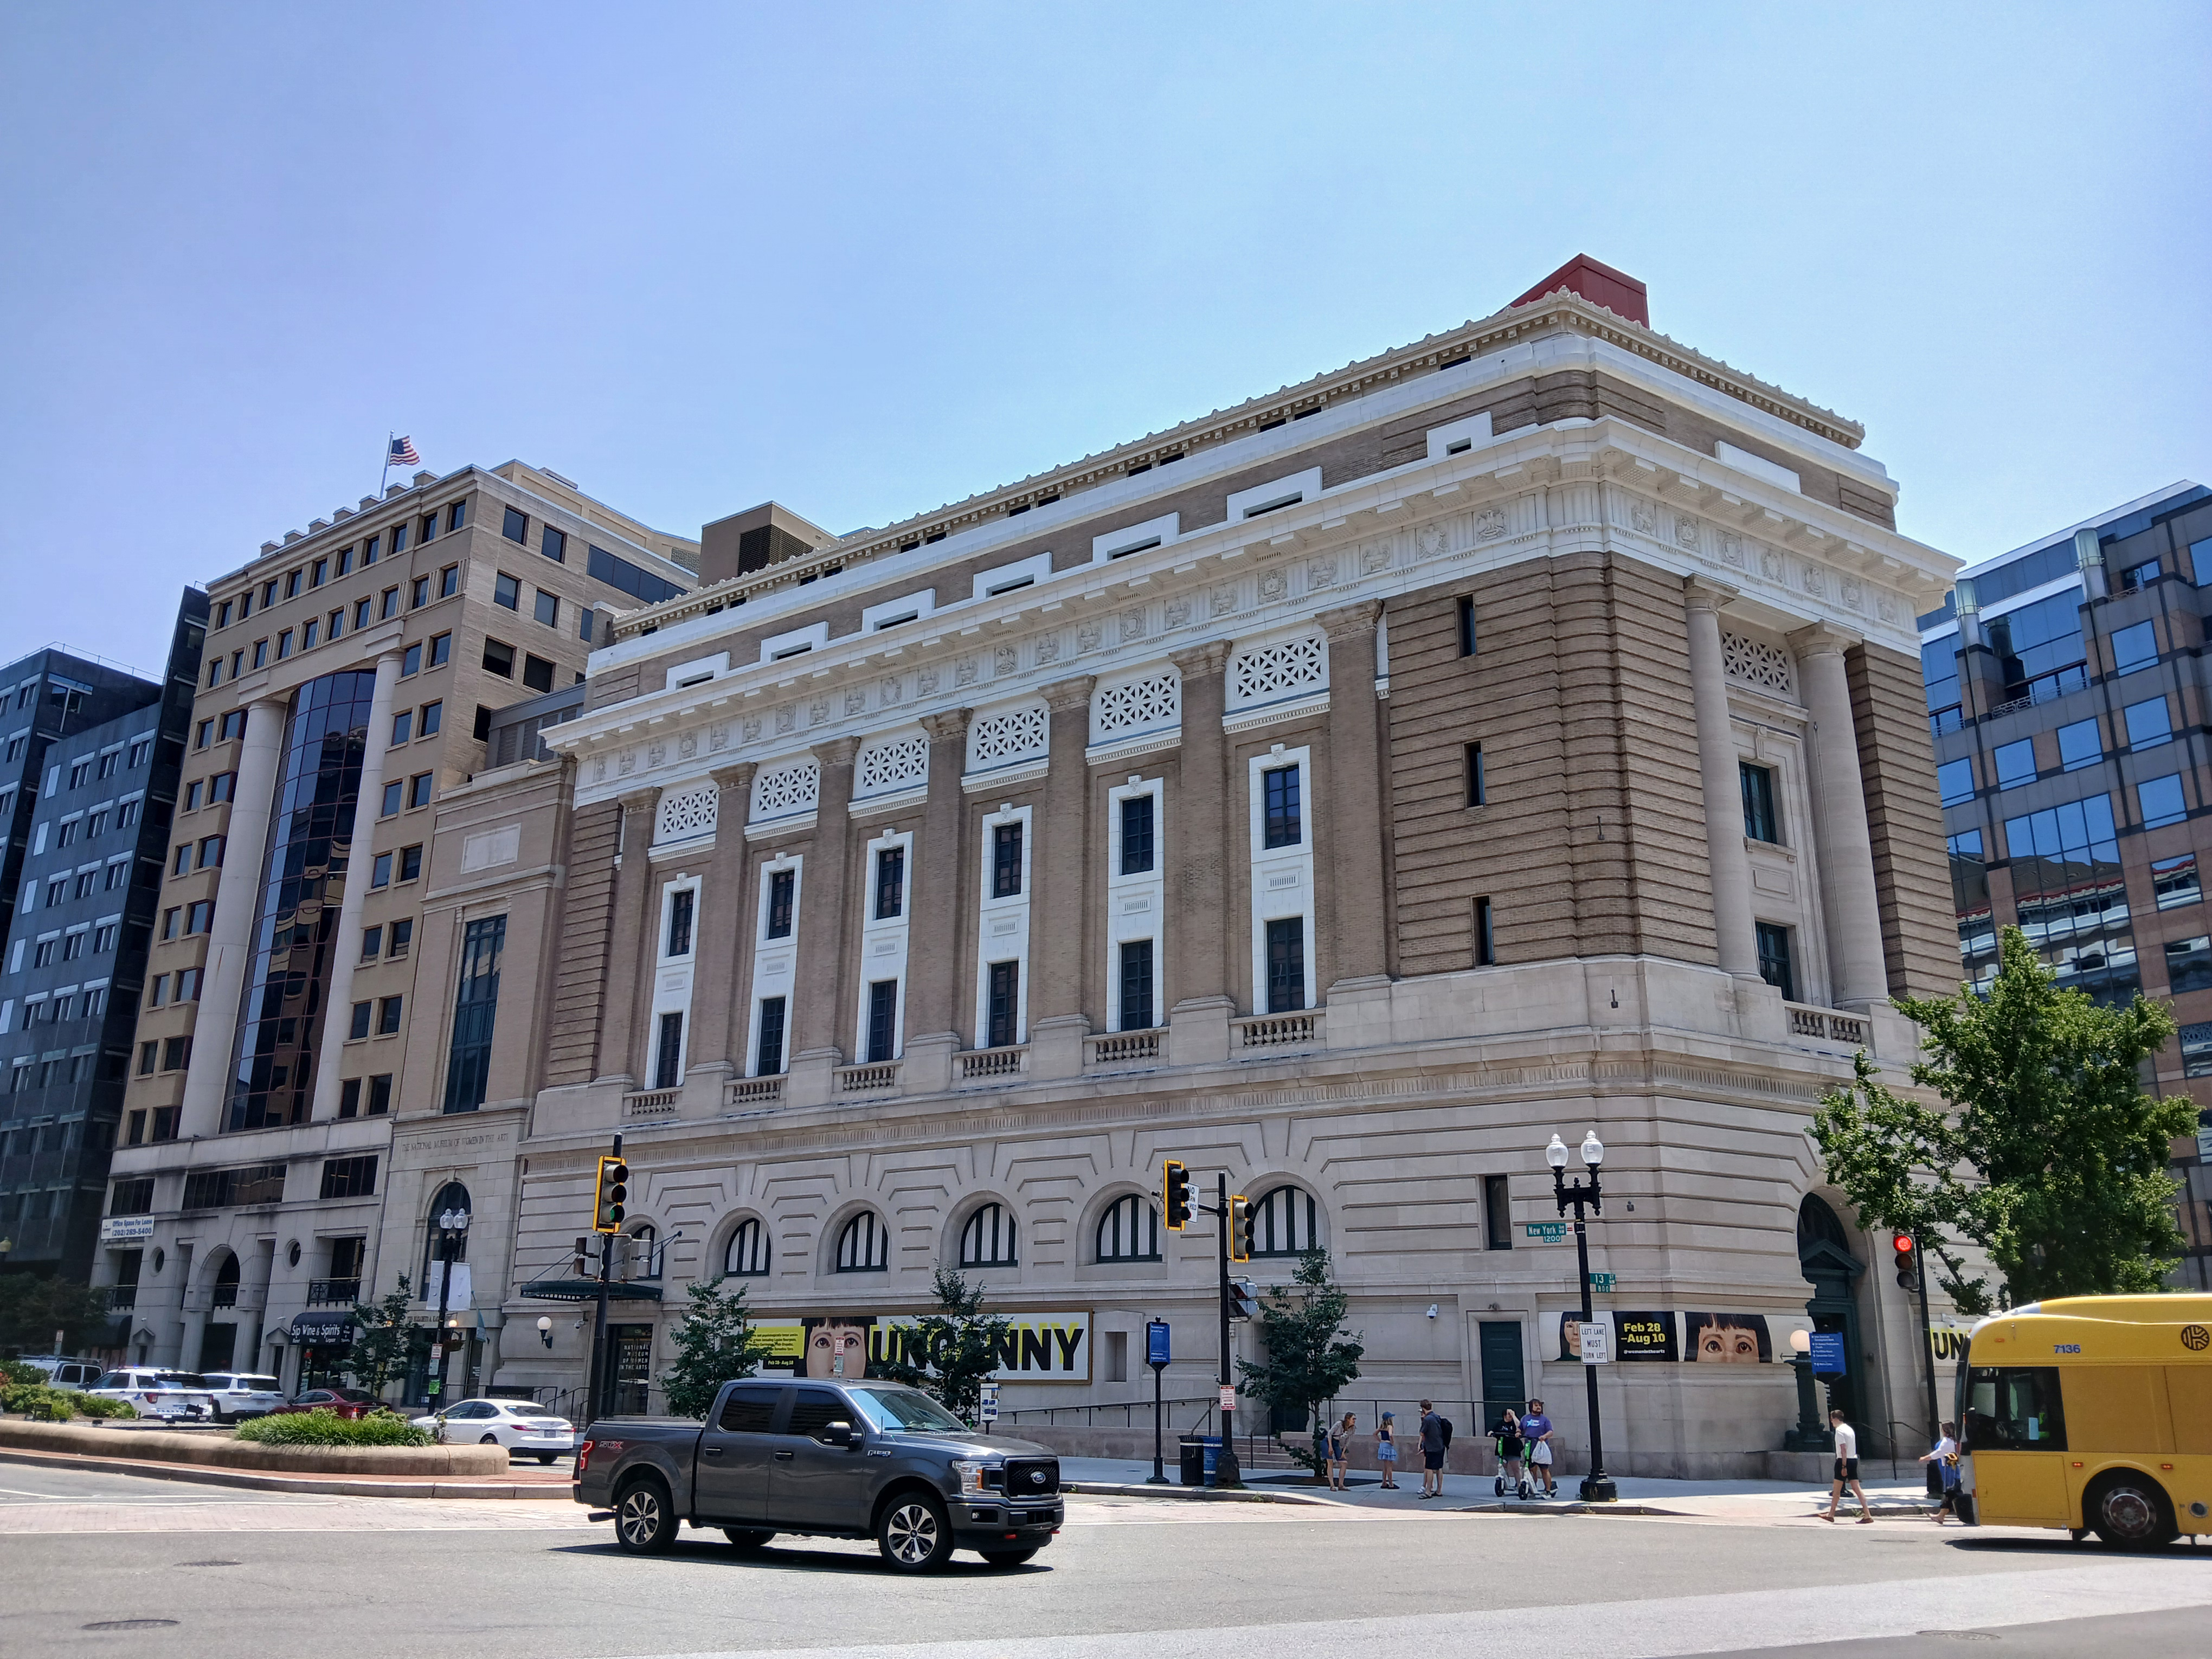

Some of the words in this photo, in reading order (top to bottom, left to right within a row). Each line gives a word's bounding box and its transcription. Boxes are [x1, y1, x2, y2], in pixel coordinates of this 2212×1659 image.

[1187, 1185, 1195, 1194] NO
[124, 1219, 134, 1228] Space
[1528, 1226, 1541, 1236] New
[1542, 1225, 1557, 1234] York
[1595, 1274, 1604, 1284] 13
[1598, 1285, 1609, 1293] 800
[292, 1324, 301, 1339] Sip
[303, 1324, 316, 1336] Wine
[321, 1323, 340, 1339] Spirits
[1623, 1323, 1645, 1333] Feb
[1647, 1323, 1661, 1333] 28
[1652, 1333, 1666, 1342] 10
[870, 1324, 1084, 1372] UNCNNY
[1587, 1340, 1601, 1348] MUST
[2053, 1345, 2081, 1353] 7136
[599, 1441, 624, 1449] STX
